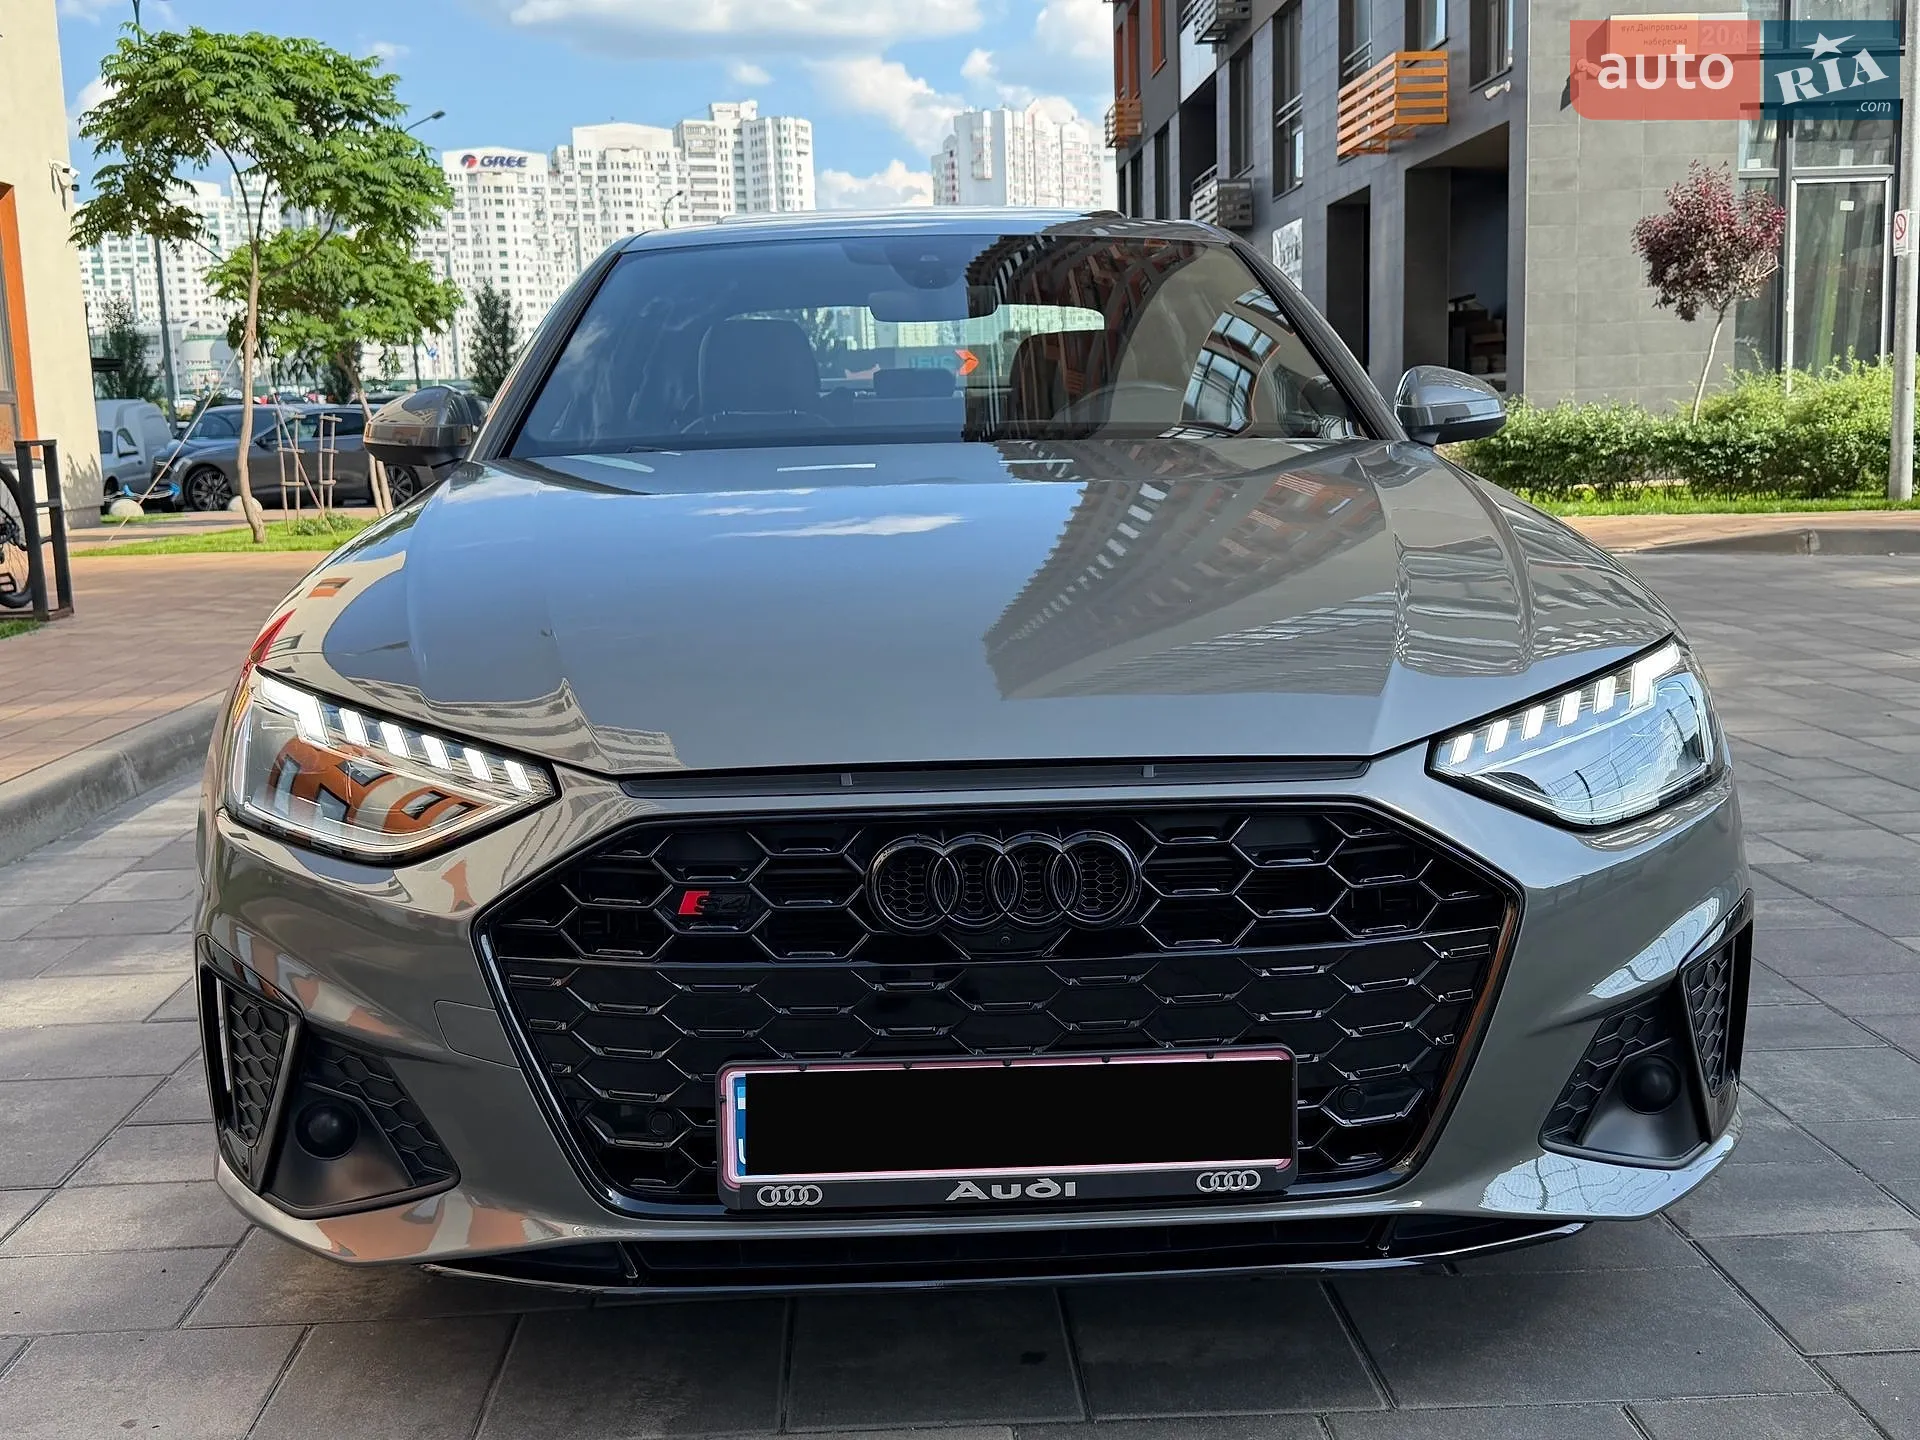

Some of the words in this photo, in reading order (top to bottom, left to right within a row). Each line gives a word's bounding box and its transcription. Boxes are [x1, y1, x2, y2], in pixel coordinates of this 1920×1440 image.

[1643, 37, 1688, 47] набережна
[480, 155, 528, 168] GREE
[945, 1178, 1076, 1201] Audi
